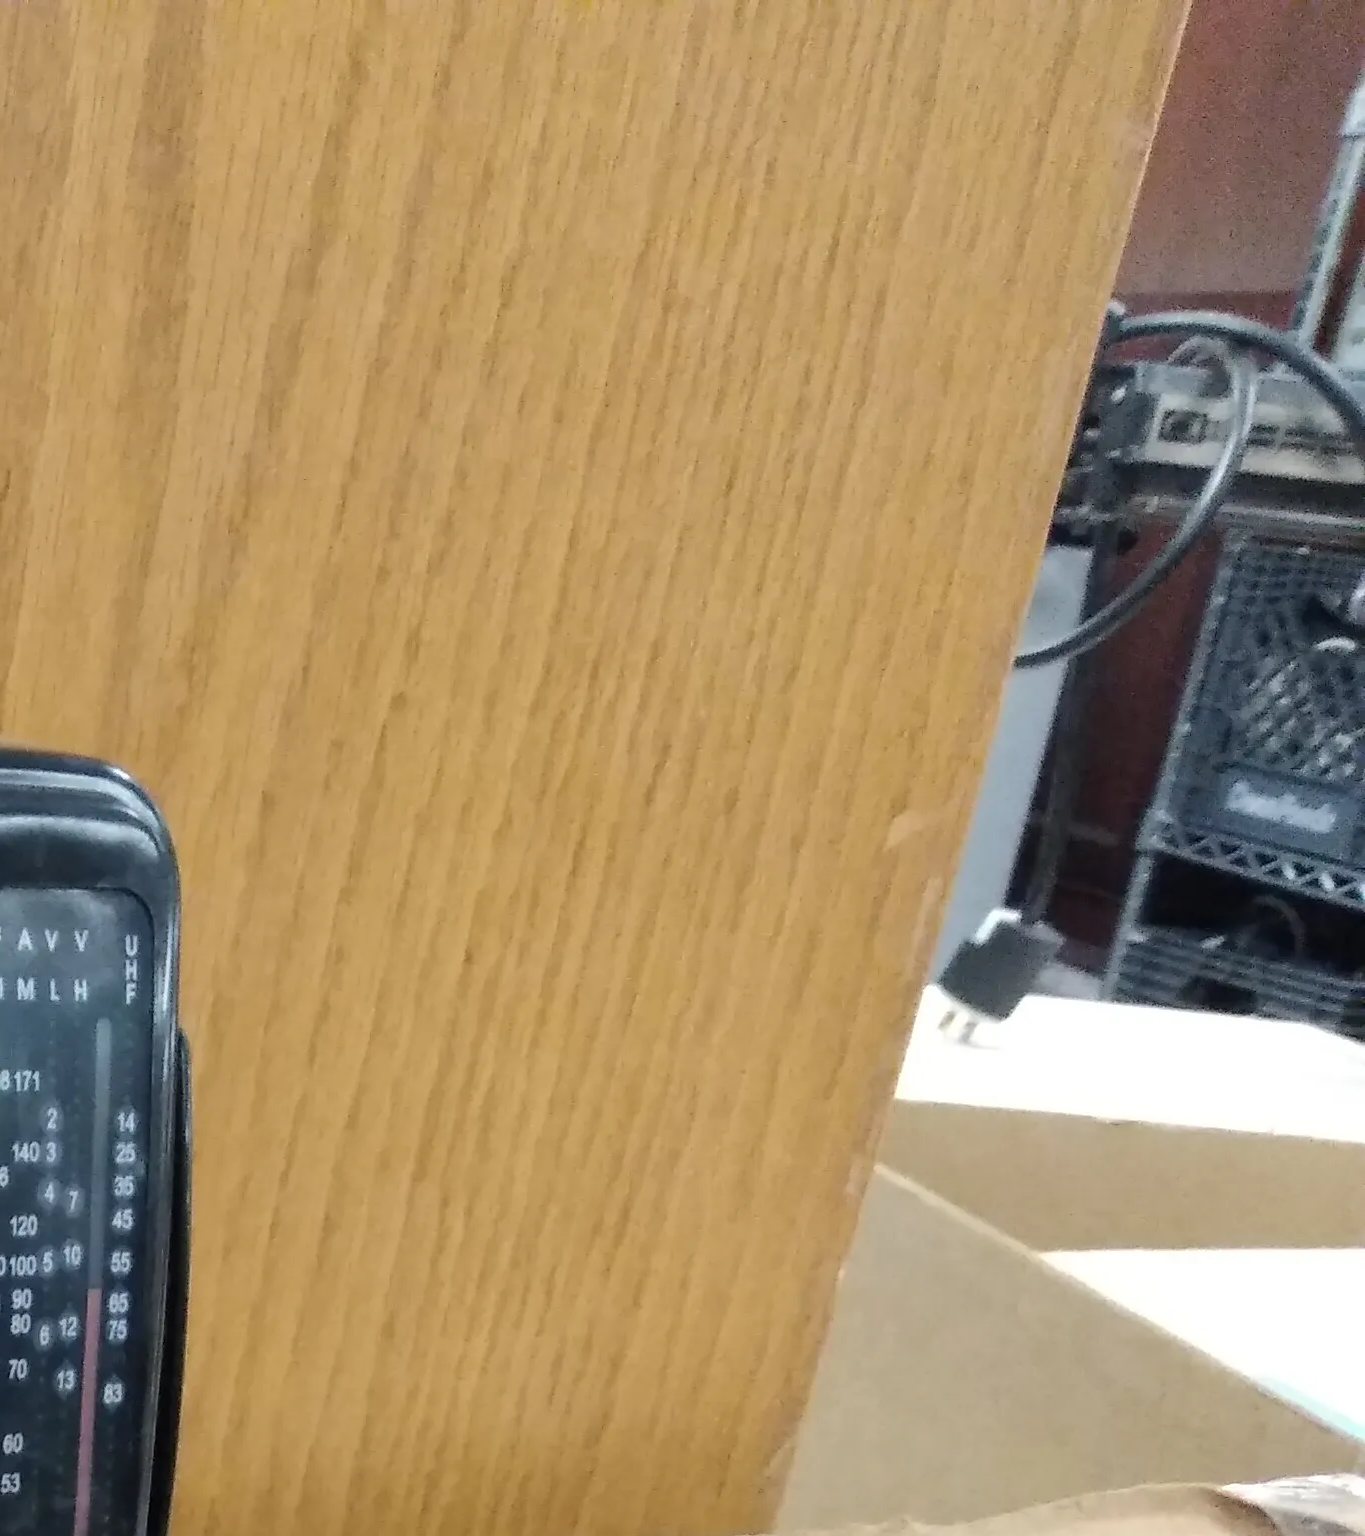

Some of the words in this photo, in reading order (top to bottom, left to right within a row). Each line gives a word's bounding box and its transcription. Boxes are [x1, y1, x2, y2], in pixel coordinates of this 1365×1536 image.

[14, 1070, 40, 1092] 171
[47, 1108, 57, 1130] 2
[118, 1111, 136, 1133] 14
[12, 1142, 40, 1164] 140
[45, 1141, 57, 1163] 3
[116, 1142, 136, 1163] 25
[44, 1182, 55, 1203] 4
[68, 1190, 79, 1212] 7
[114, 1175, 135, 1198] 35
[10, 1215, 38, 1237] 120
[112, 1209, 134, 1231] 45
[9, 1255, 37, 1276] 100
[42, 1251, 53, 1273] 5
[64, 1245, 81, 1266] 10
[110, 1251, 131, 1274] 55
[11, 1288, 32, 1310] 90
[10, 1313, 31, 1335] 80
[39, 1324, 50, 1346] 6
[59, 1316, 79, 1338] 12
[108, 1318, 129, 1341] 75
[8, 1358, 29, 1380] 70
[56, 1369, 75, 1391] 13
[3, 1433, 24, 1456] 60
[0, 1472, 21, 1494] 53
